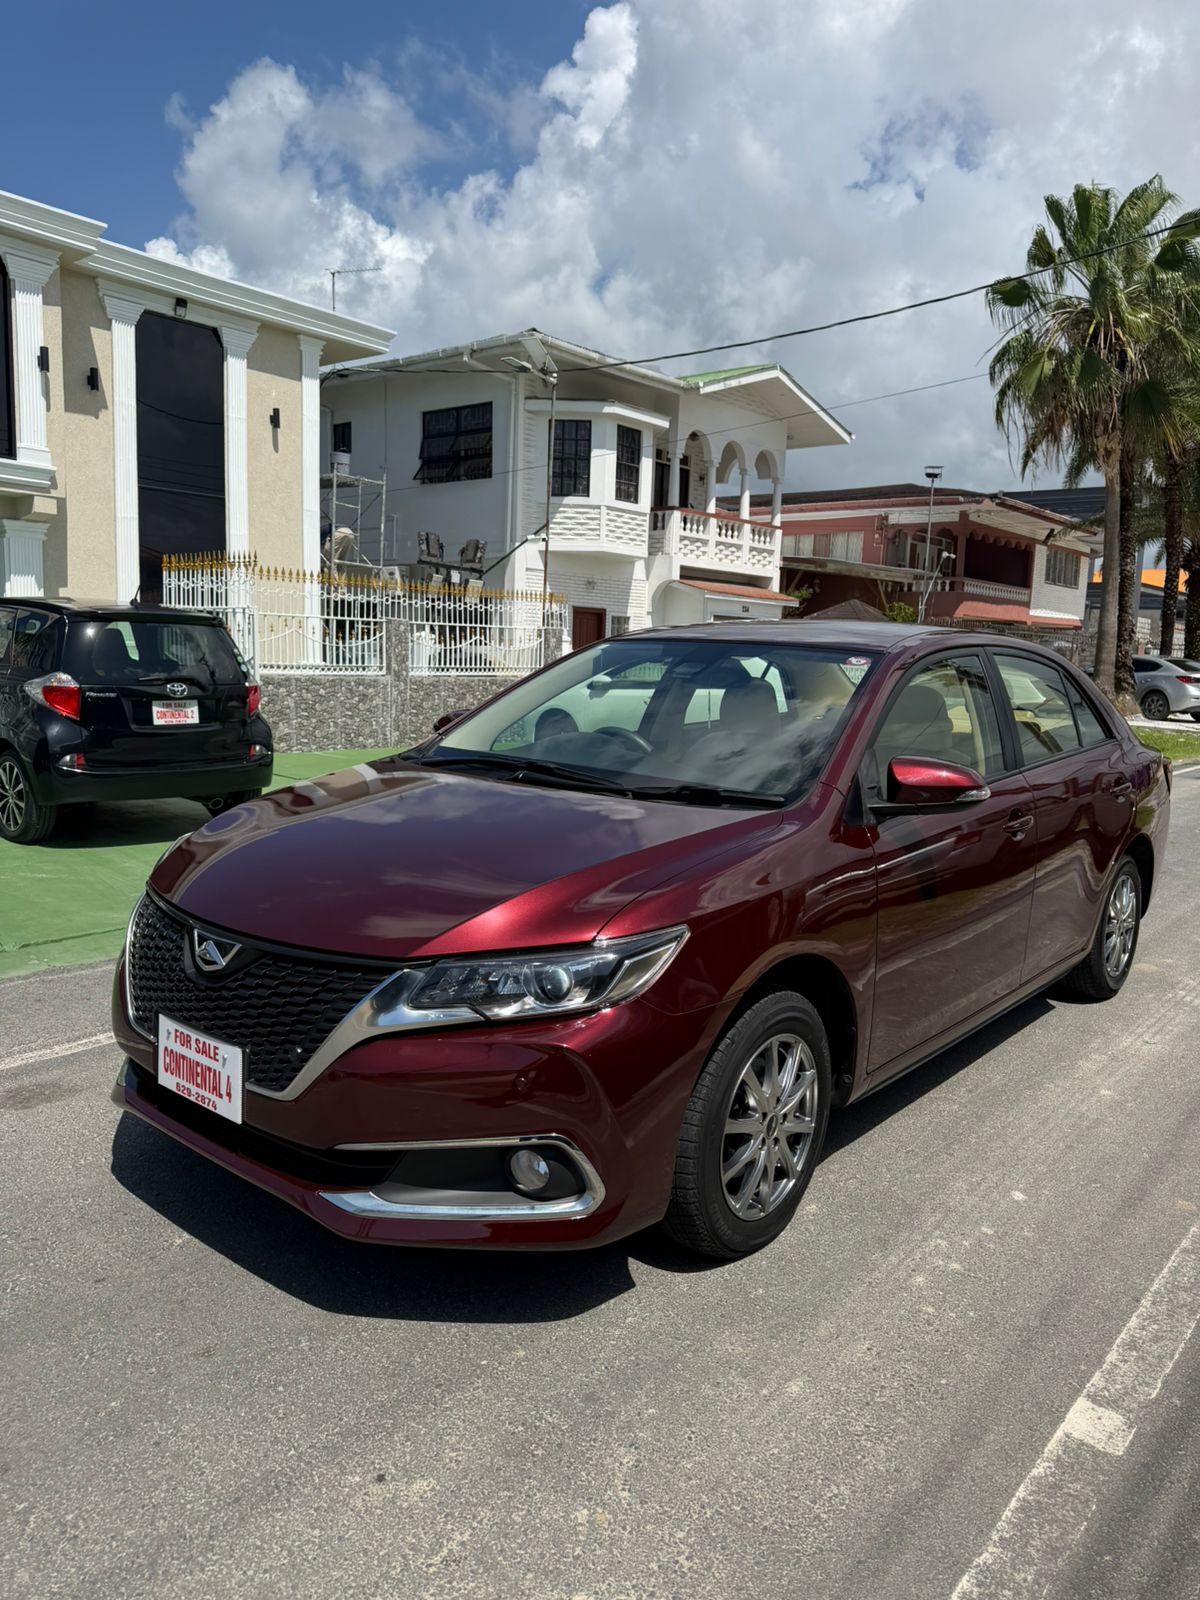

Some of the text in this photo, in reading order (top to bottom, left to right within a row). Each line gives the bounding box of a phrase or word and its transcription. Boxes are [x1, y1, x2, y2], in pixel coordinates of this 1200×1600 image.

[156, 710, 190, 720] CONTINENTAL
[174, 1028, 220, 1062] FOR SALE
[163, 1046, 232, 1103] CONTINENTAL 4
[175, 1082, 217, 1110] 629-2874
